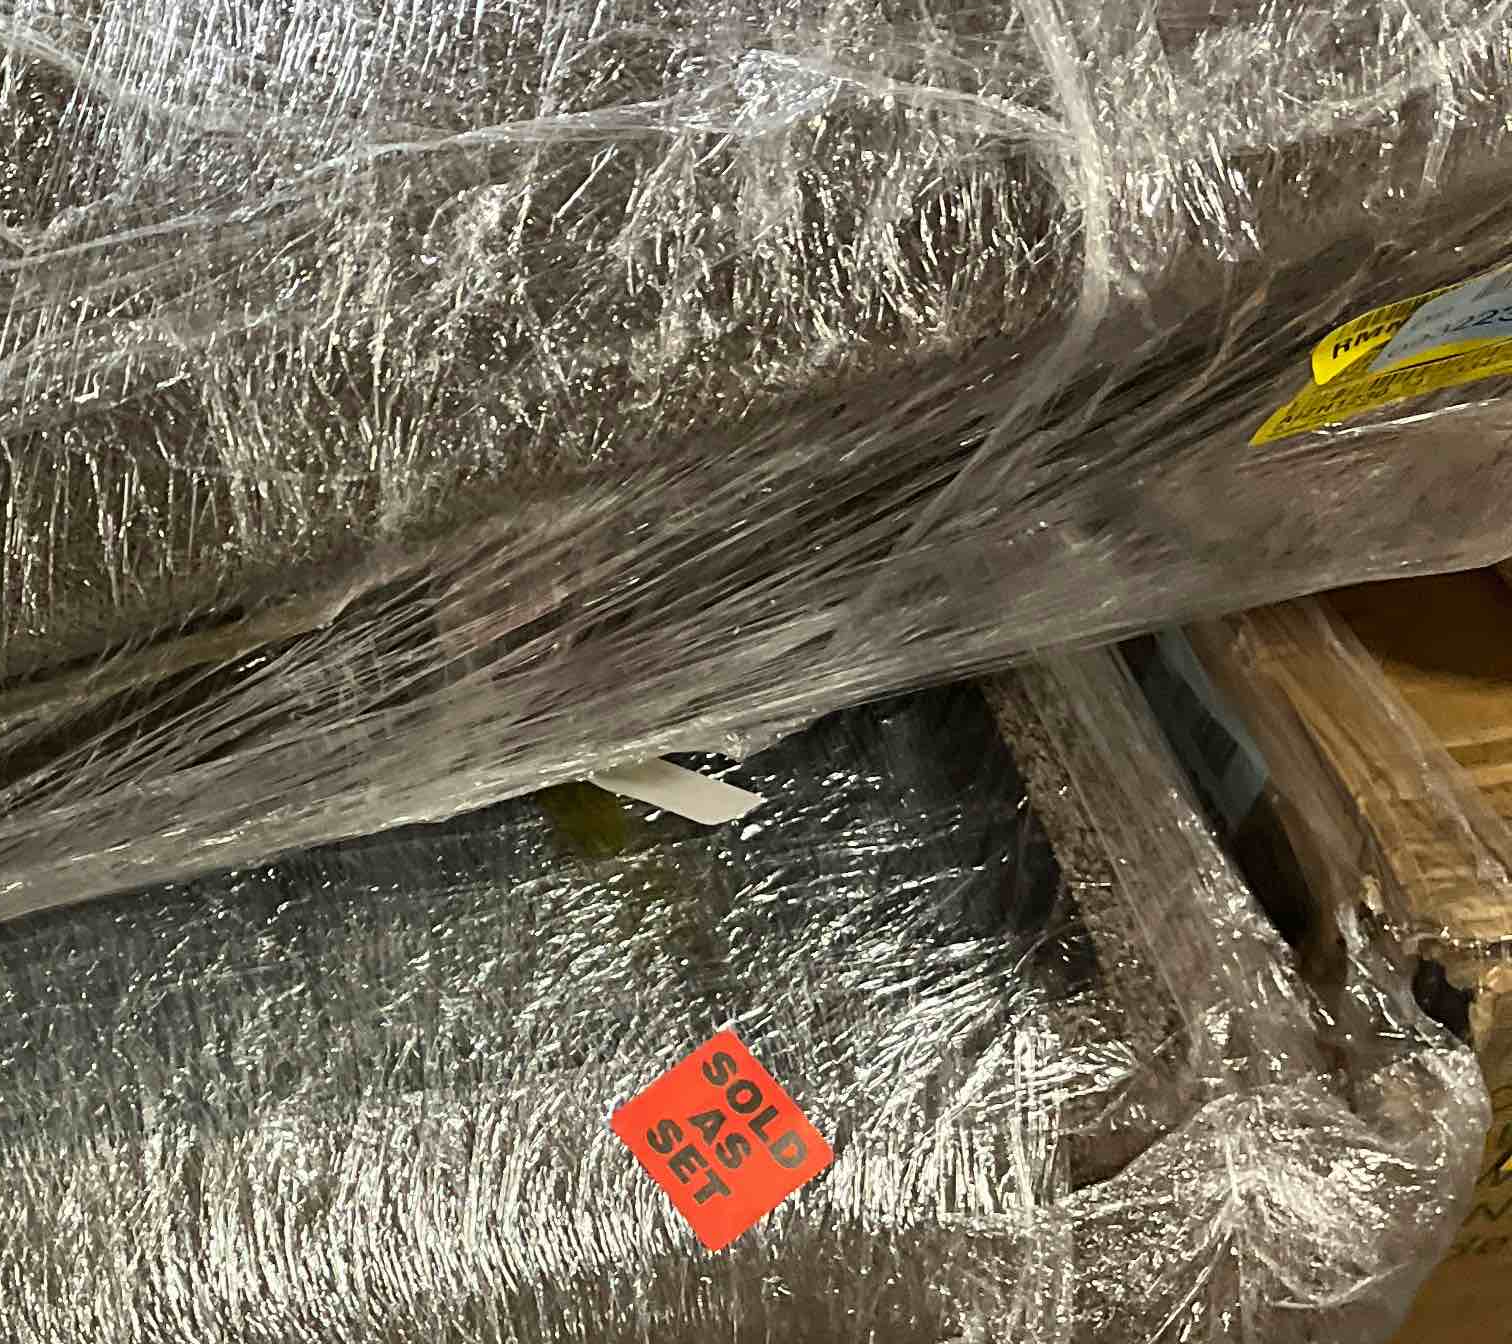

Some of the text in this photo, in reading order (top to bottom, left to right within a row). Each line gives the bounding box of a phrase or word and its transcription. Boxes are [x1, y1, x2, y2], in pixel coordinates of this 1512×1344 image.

[687, 1108, 772, 1169] AS
[701, 1051, 809, 1169] SOLD
[646, 1118, 733, 1205] SET
